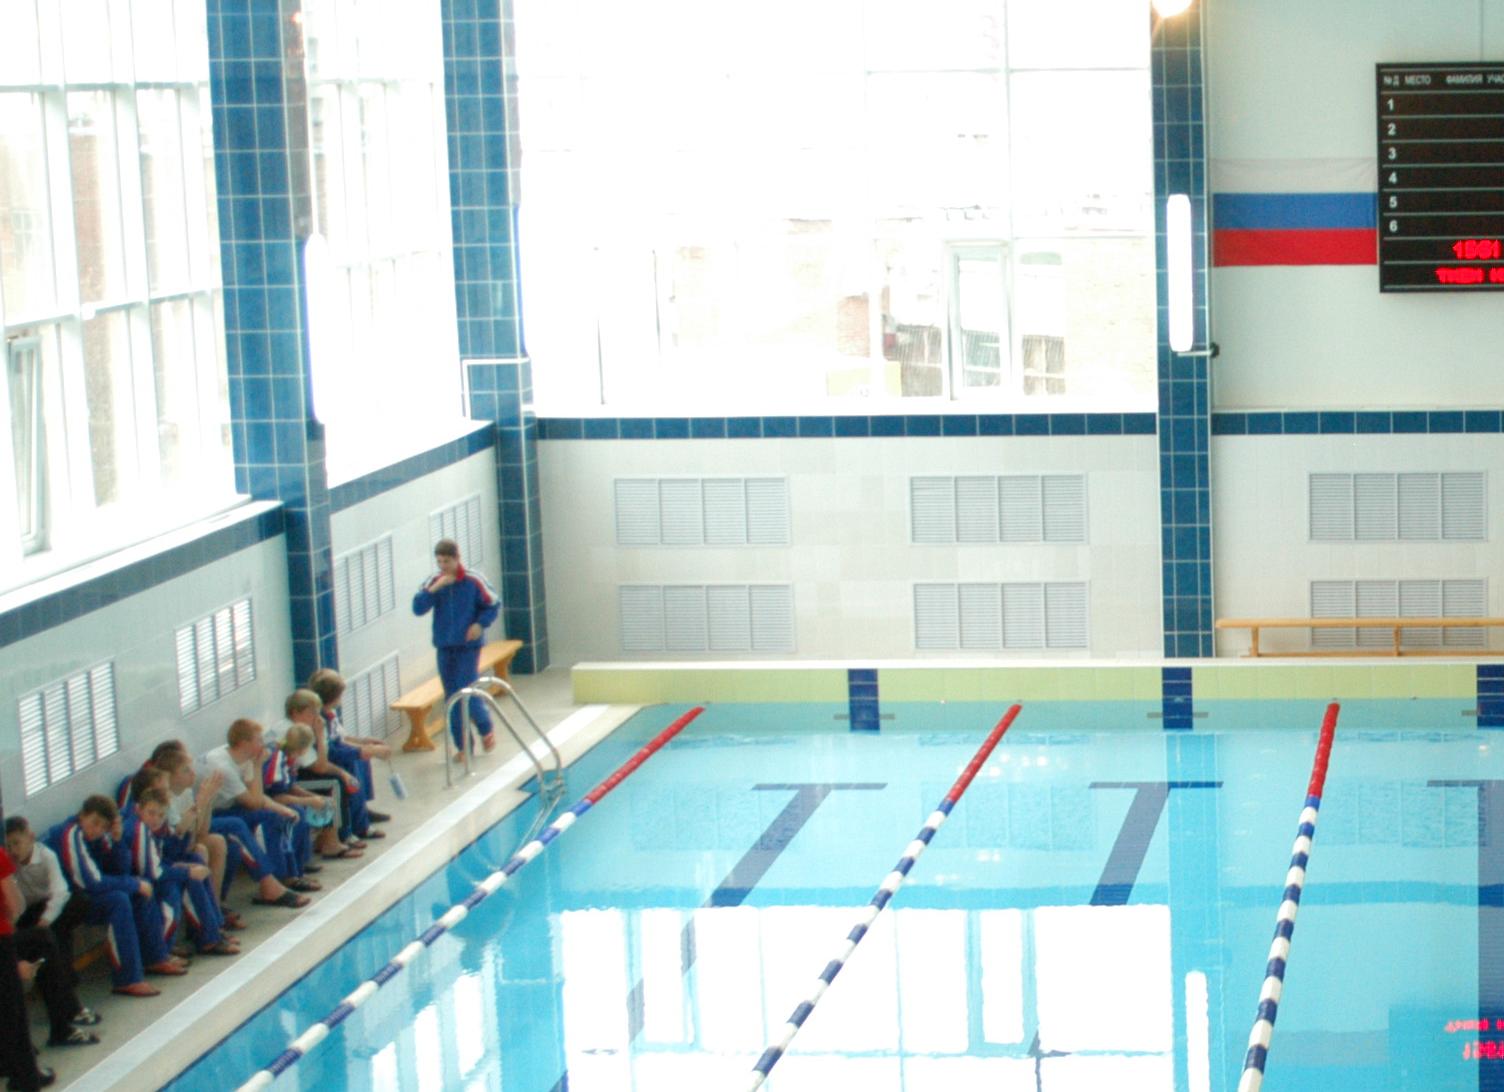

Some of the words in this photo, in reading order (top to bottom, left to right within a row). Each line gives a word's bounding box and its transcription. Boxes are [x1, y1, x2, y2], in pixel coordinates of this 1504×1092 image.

[1386, 98, 1394, 111] 1
[1387, 122, 1397, 136] 2
[1388, 147, 1397, 160] 3
[1388, 171, 1398, 184] 4
[1389, 195, 1398, 209] 5
[1389, 219, 1399, 233] 6
